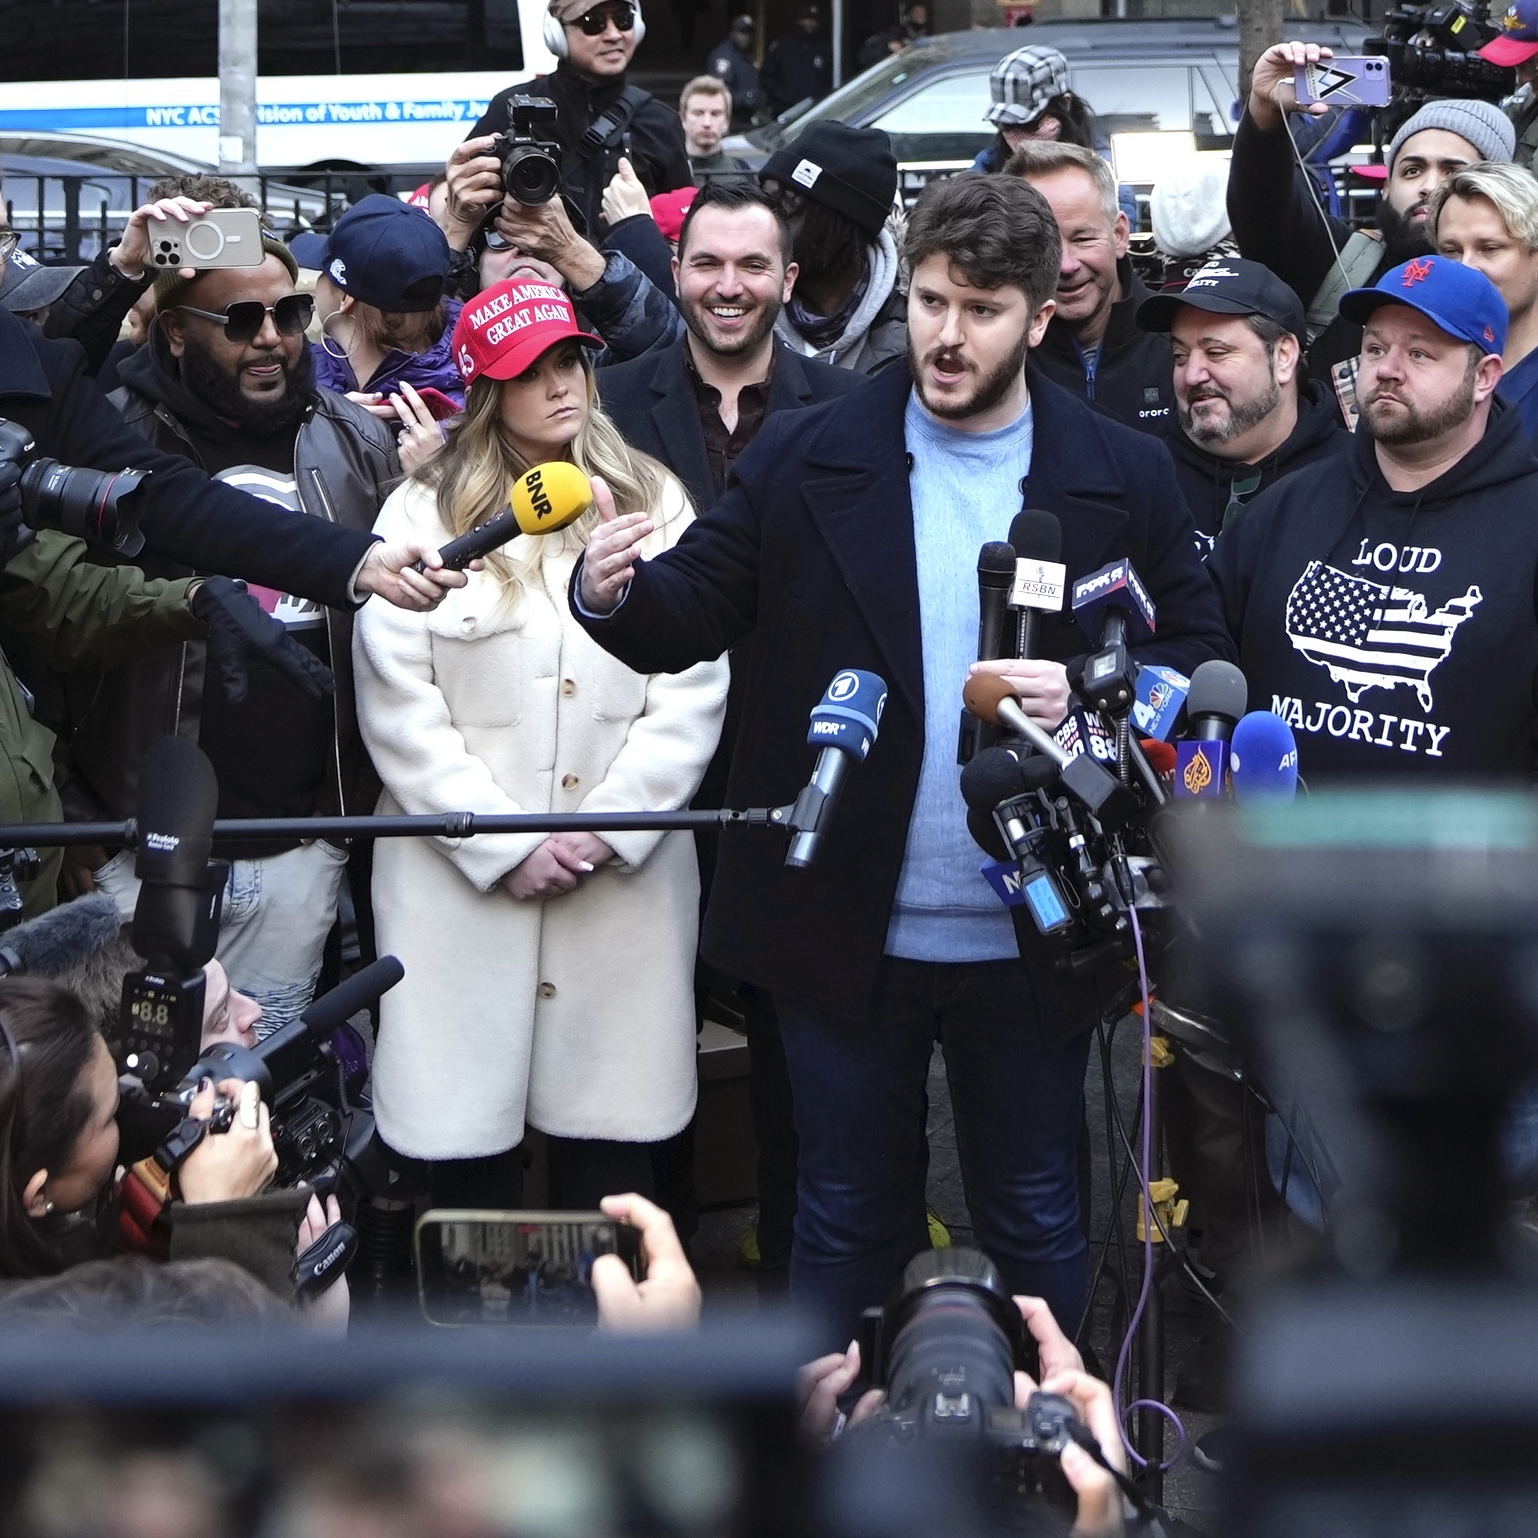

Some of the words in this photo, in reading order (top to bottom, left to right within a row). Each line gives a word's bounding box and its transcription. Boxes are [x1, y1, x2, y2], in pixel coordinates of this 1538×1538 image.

[146, 108, 186, 126] NYC
[258, 103, 303, 124] ision
[309, 102, 327, 122] of
[329, 103, 382, 122] Youth
[385, 102, 400, 120] &
[403, 100, 464, 123] Family
[469, 292, 514, 331] MAKE
[512, 284, 570, 305] AMERICA
[486, 308, 534, 346] GREAT
[534, 303, 571, 323] AGAIN
[525, 470, 552, 521] BNR
[1352, 538, 1442, 573] LOUD
[1022, 582, 1056, 596] RSBN
[813, 721, 841, 736] WDR
[1053, 715, 1079, 746] CBS
[1133, 699, 1157, 729] 4
[1271, 694, 1451, 757] MAJORITY
[1278, 747, 1298, 772] AF
[313, 1241, 346, 1276] Canon
